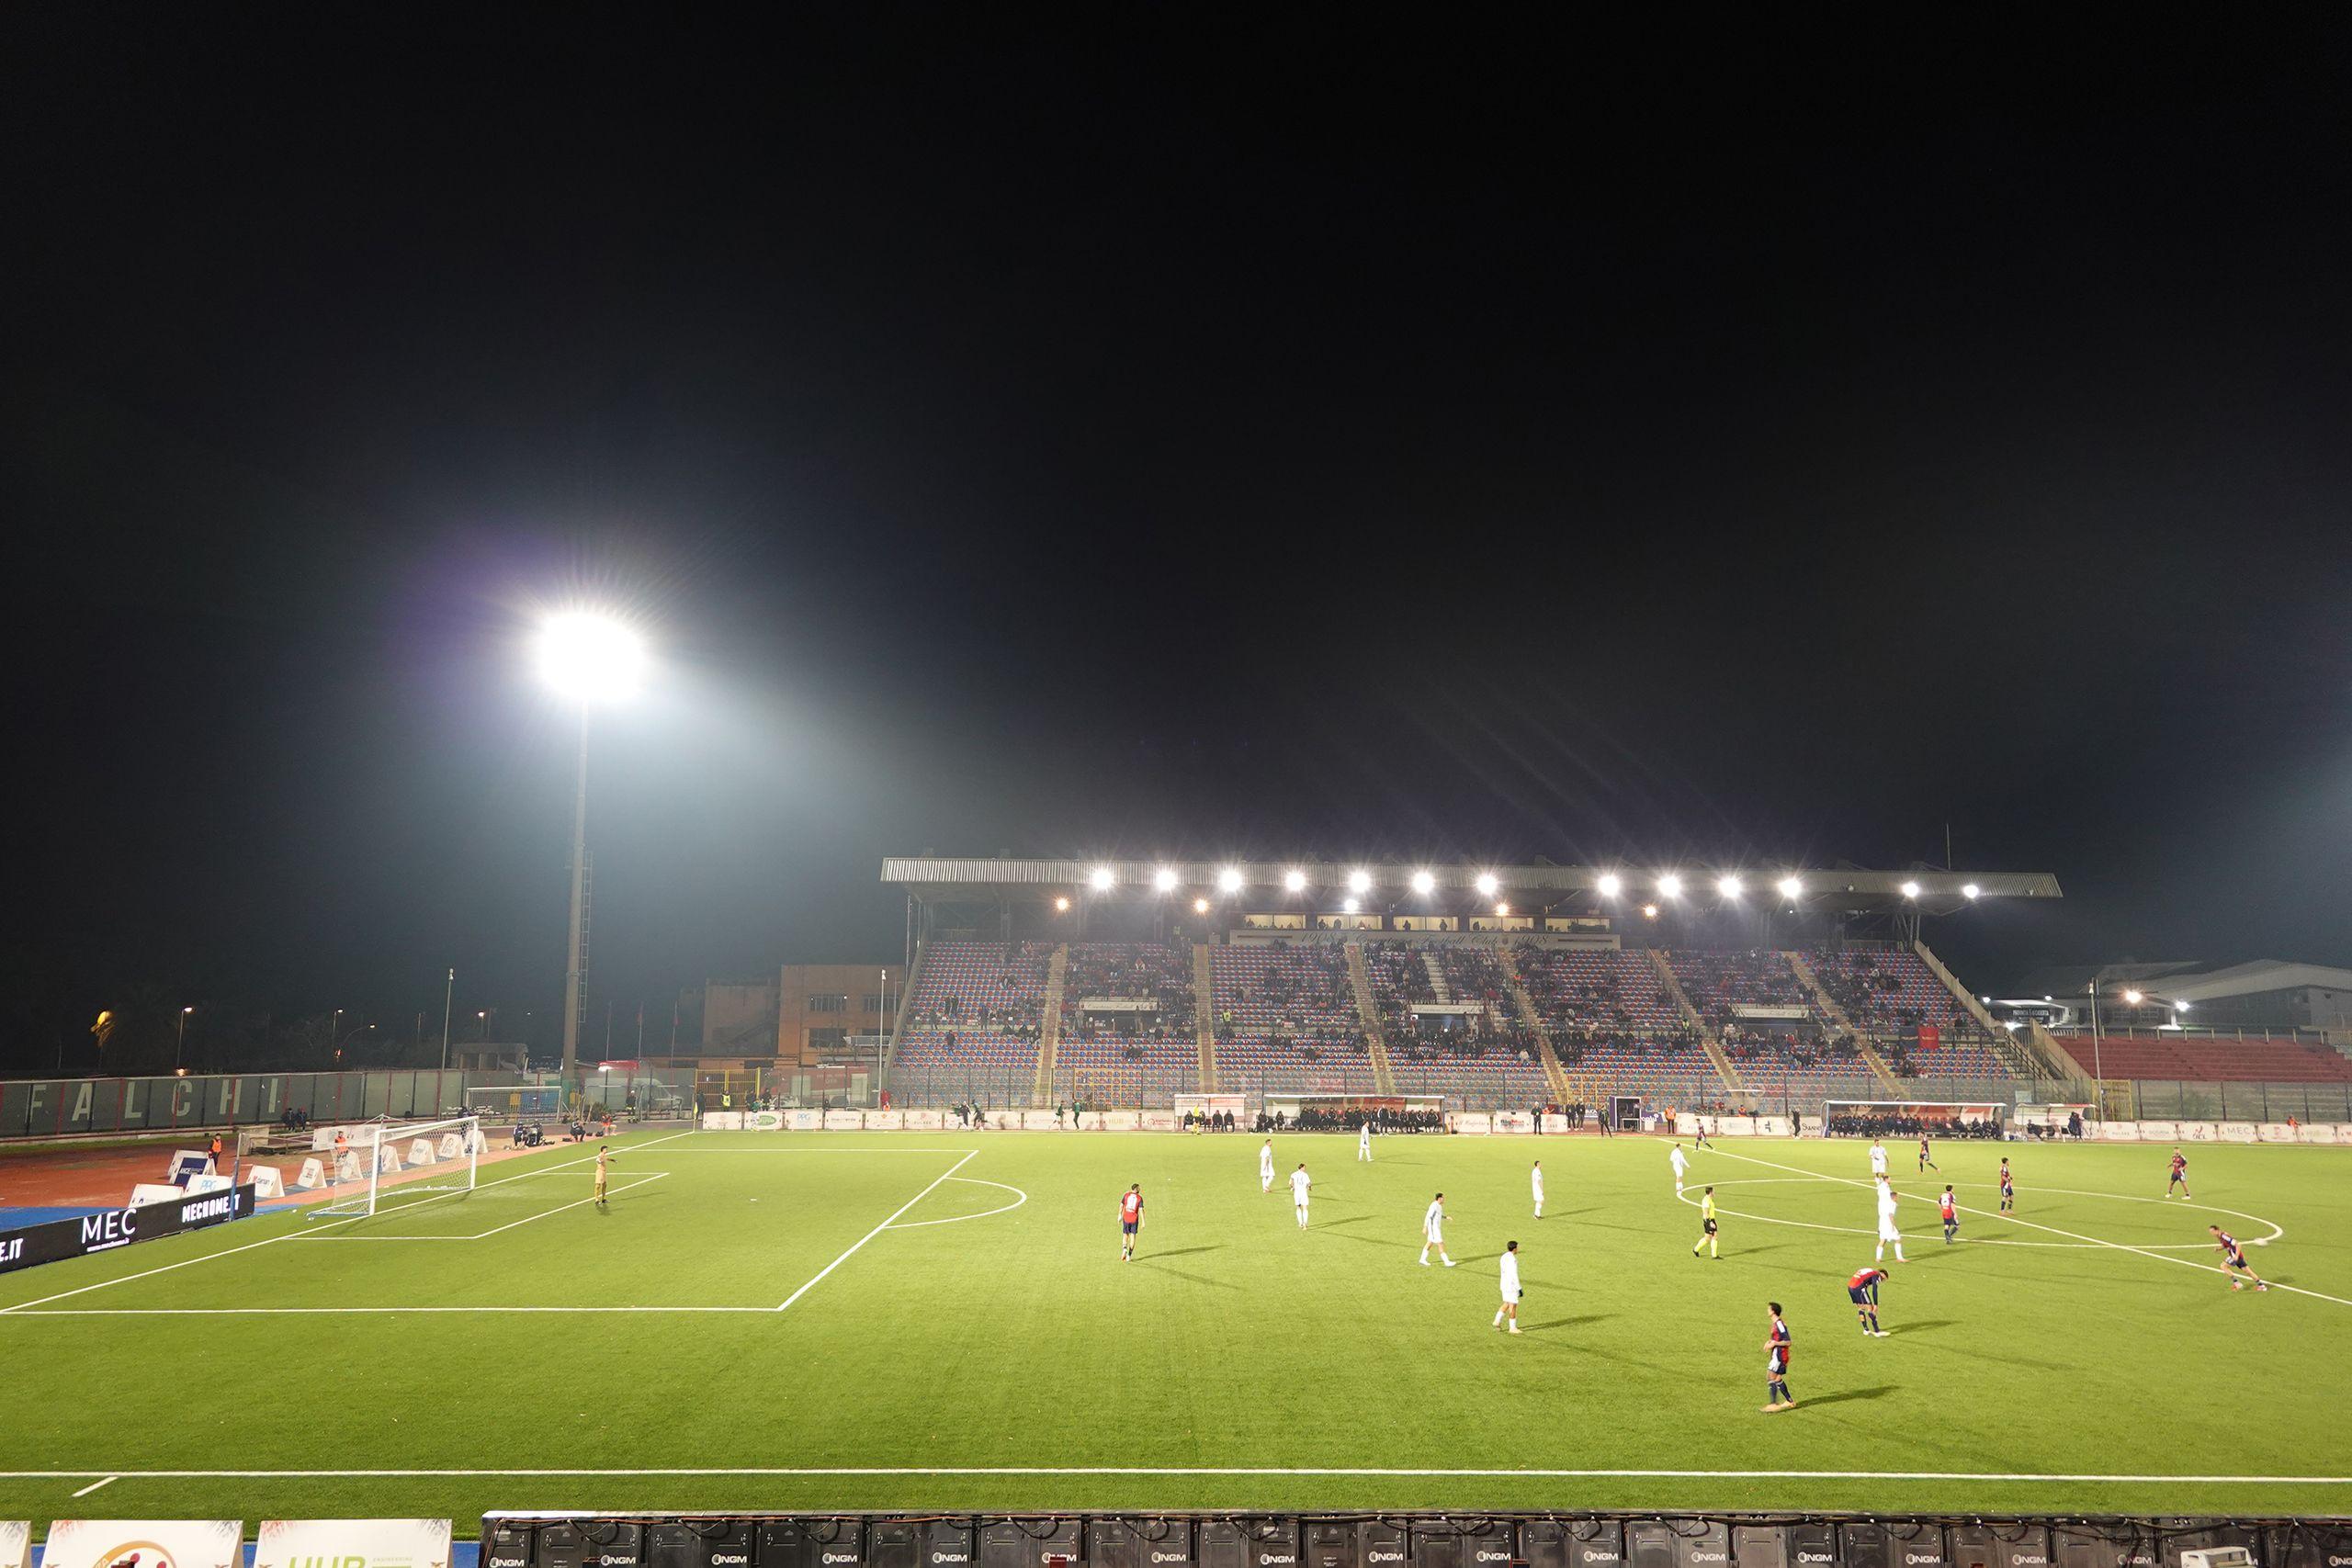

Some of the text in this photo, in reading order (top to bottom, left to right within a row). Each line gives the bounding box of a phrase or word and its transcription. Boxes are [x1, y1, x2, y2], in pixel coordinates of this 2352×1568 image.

[26, 1078, 279, 1122] FALCHI
[182, 1194, 240, 1223] MECHOME.T
[82, 1208, 137, 1244] MEC
[608, 1556, 636, 1564] NGM
[719, 1555, 747, 1563] NGM
[831, 1554, 857, 1562] NGM
[941, 1554, 967, 1562] NGM
[1159, 1553, 1186, 1562] NGM
[1268, 1555, 1295, 1563] NGM
[1376, 1552, 1403, 1561] NGM
[1485, 1552, 1511, 1561] NGM
[1591, 1552, 1619, 1561] NGM
[1805, 1553, 1832, 1562] NGM
[1913, 1555, 1940, 1563] NGM
[2020, 1555, 2046, 1563] NGM
[497, 1559, 525, 1567] NGM
